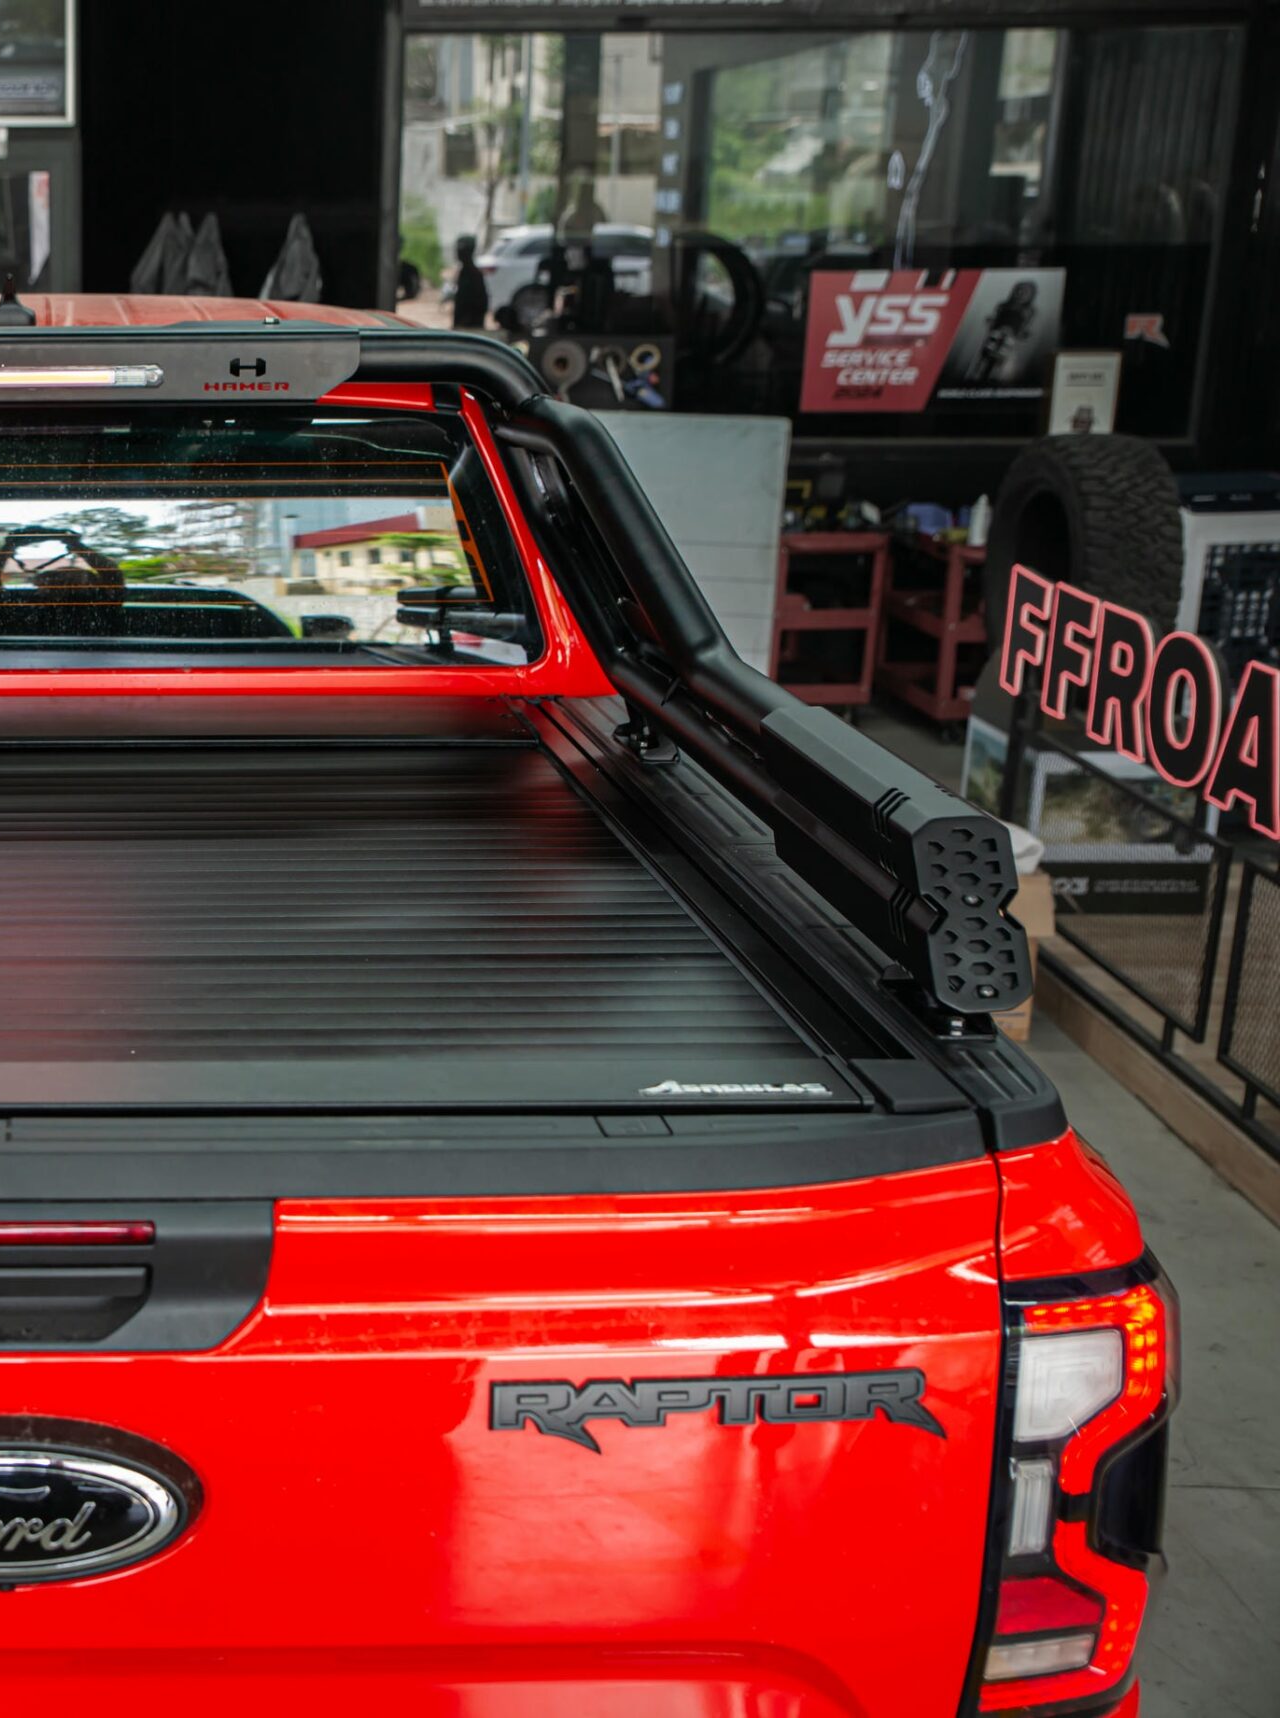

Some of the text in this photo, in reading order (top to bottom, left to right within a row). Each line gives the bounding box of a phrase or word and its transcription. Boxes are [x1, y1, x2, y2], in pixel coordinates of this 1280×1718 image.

[821, 349, 912, 368] SERVICE
[836, 367, 919, 386] CENTER
[204, 382, 289, 391] HAMER
[489, 1367, 948, 1455] RAPTOR
